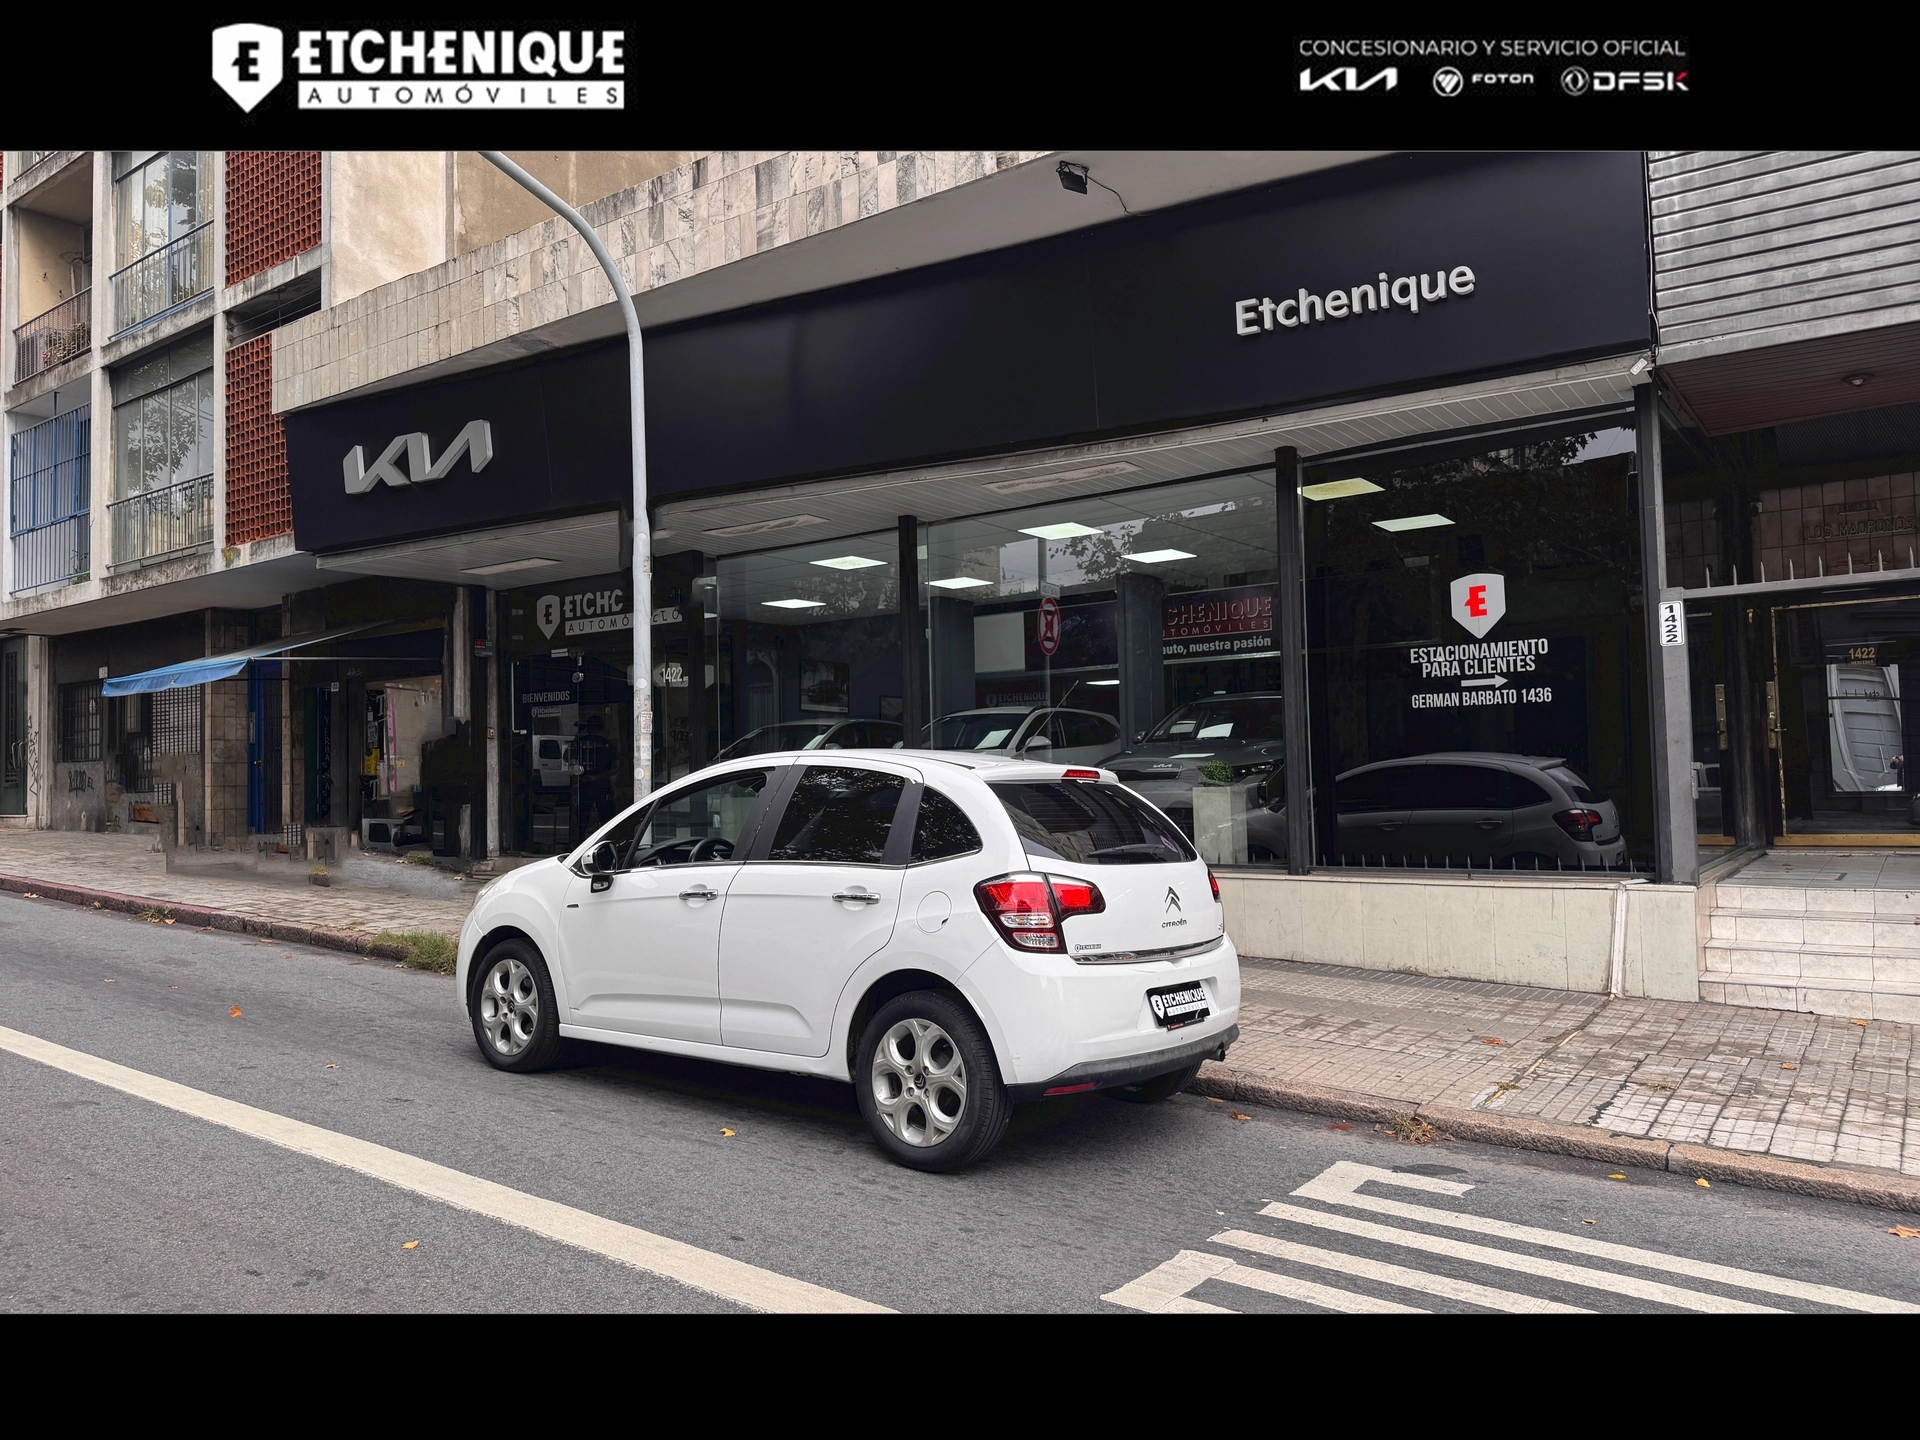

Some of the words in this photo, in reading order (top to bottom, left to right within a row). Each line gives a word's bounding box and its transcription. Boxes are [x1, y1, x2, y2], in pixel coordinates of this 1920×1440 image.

[1235, 265, 1476, 336] Etchenique
[343, 419, 493, 494] KIA
[1167, 596, 1272, 626] CHENIQUE
[1163, 620, 1269, 637] TOMÓVILES
[1664, 604, 1679, 643] 1422
[1189, 639, 1231, 653] nuestra
[1233, 635, 1271, 651] pasión
[1410, 638, 1549, 664] ESTACIONAMIENTO
[1848, 647, 1876, 660] 1422
[661, 666, 683, 684] 1422
[1422, 660, 1461, 678] PARA
[1464, 655, 1536, 675] CLIENTES
[522, 690, 571, 704] BIENVENIDOS
[1411, 692, 1460, 709] GERMAN
[1462, 689, 1517, 706] BARBATO
[1521, 687, 1552, 703] 1436
[1162, 987, 1206, 1008] ETCHENIQUE
